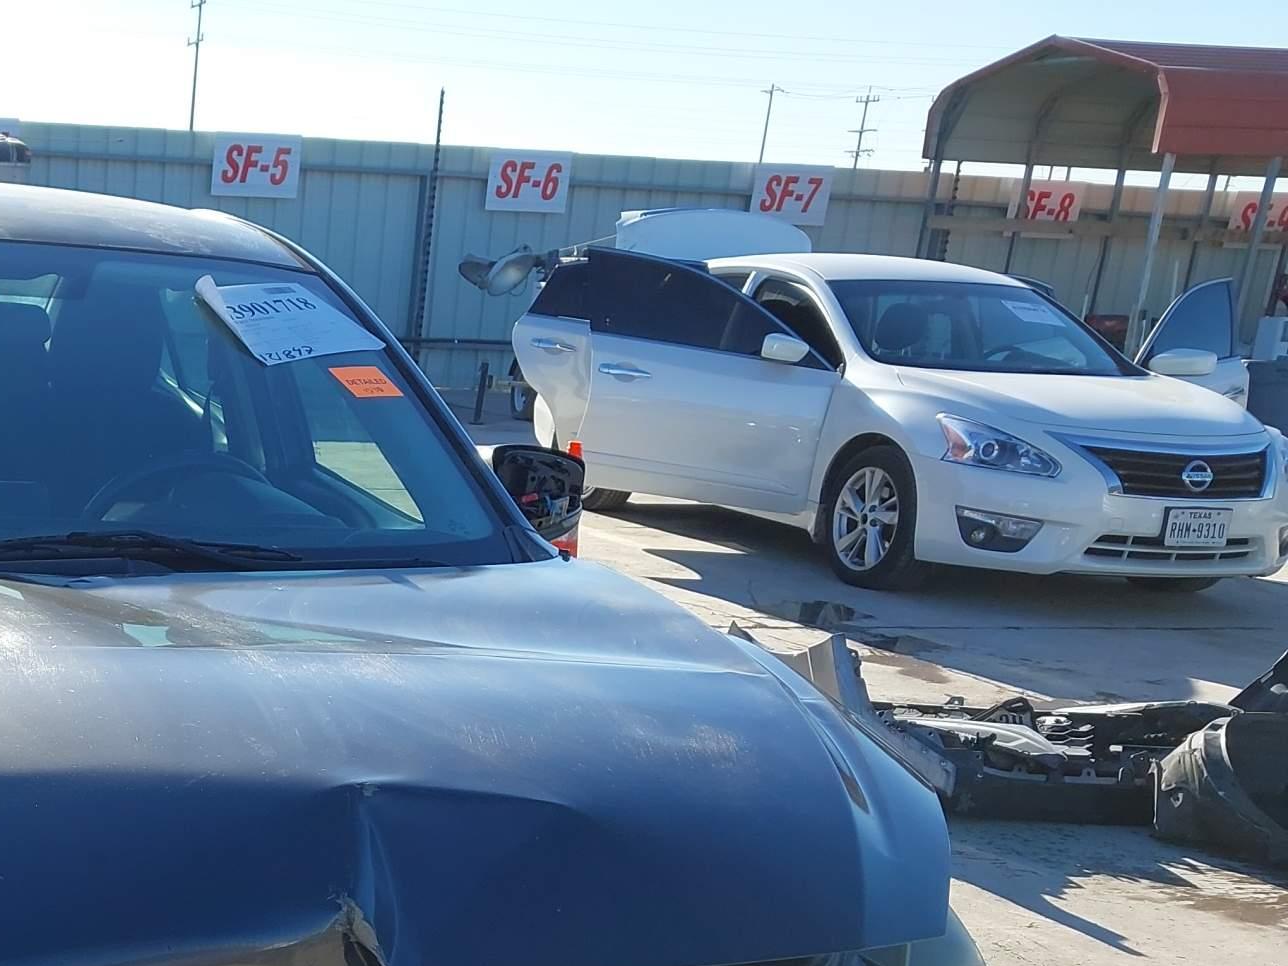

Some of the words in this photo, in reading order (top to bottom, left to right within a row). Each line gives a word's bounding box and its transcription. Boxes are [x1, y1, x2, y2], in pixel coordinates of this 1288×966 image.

[221, 143, 292, 185] SF-5
[495, 159, 562, 200] SF-6
[759, 174, 824, 213] SF-7
[225, 296, 317, 321] 3901718
[1189, 511, 1212, 519] TEXAS
